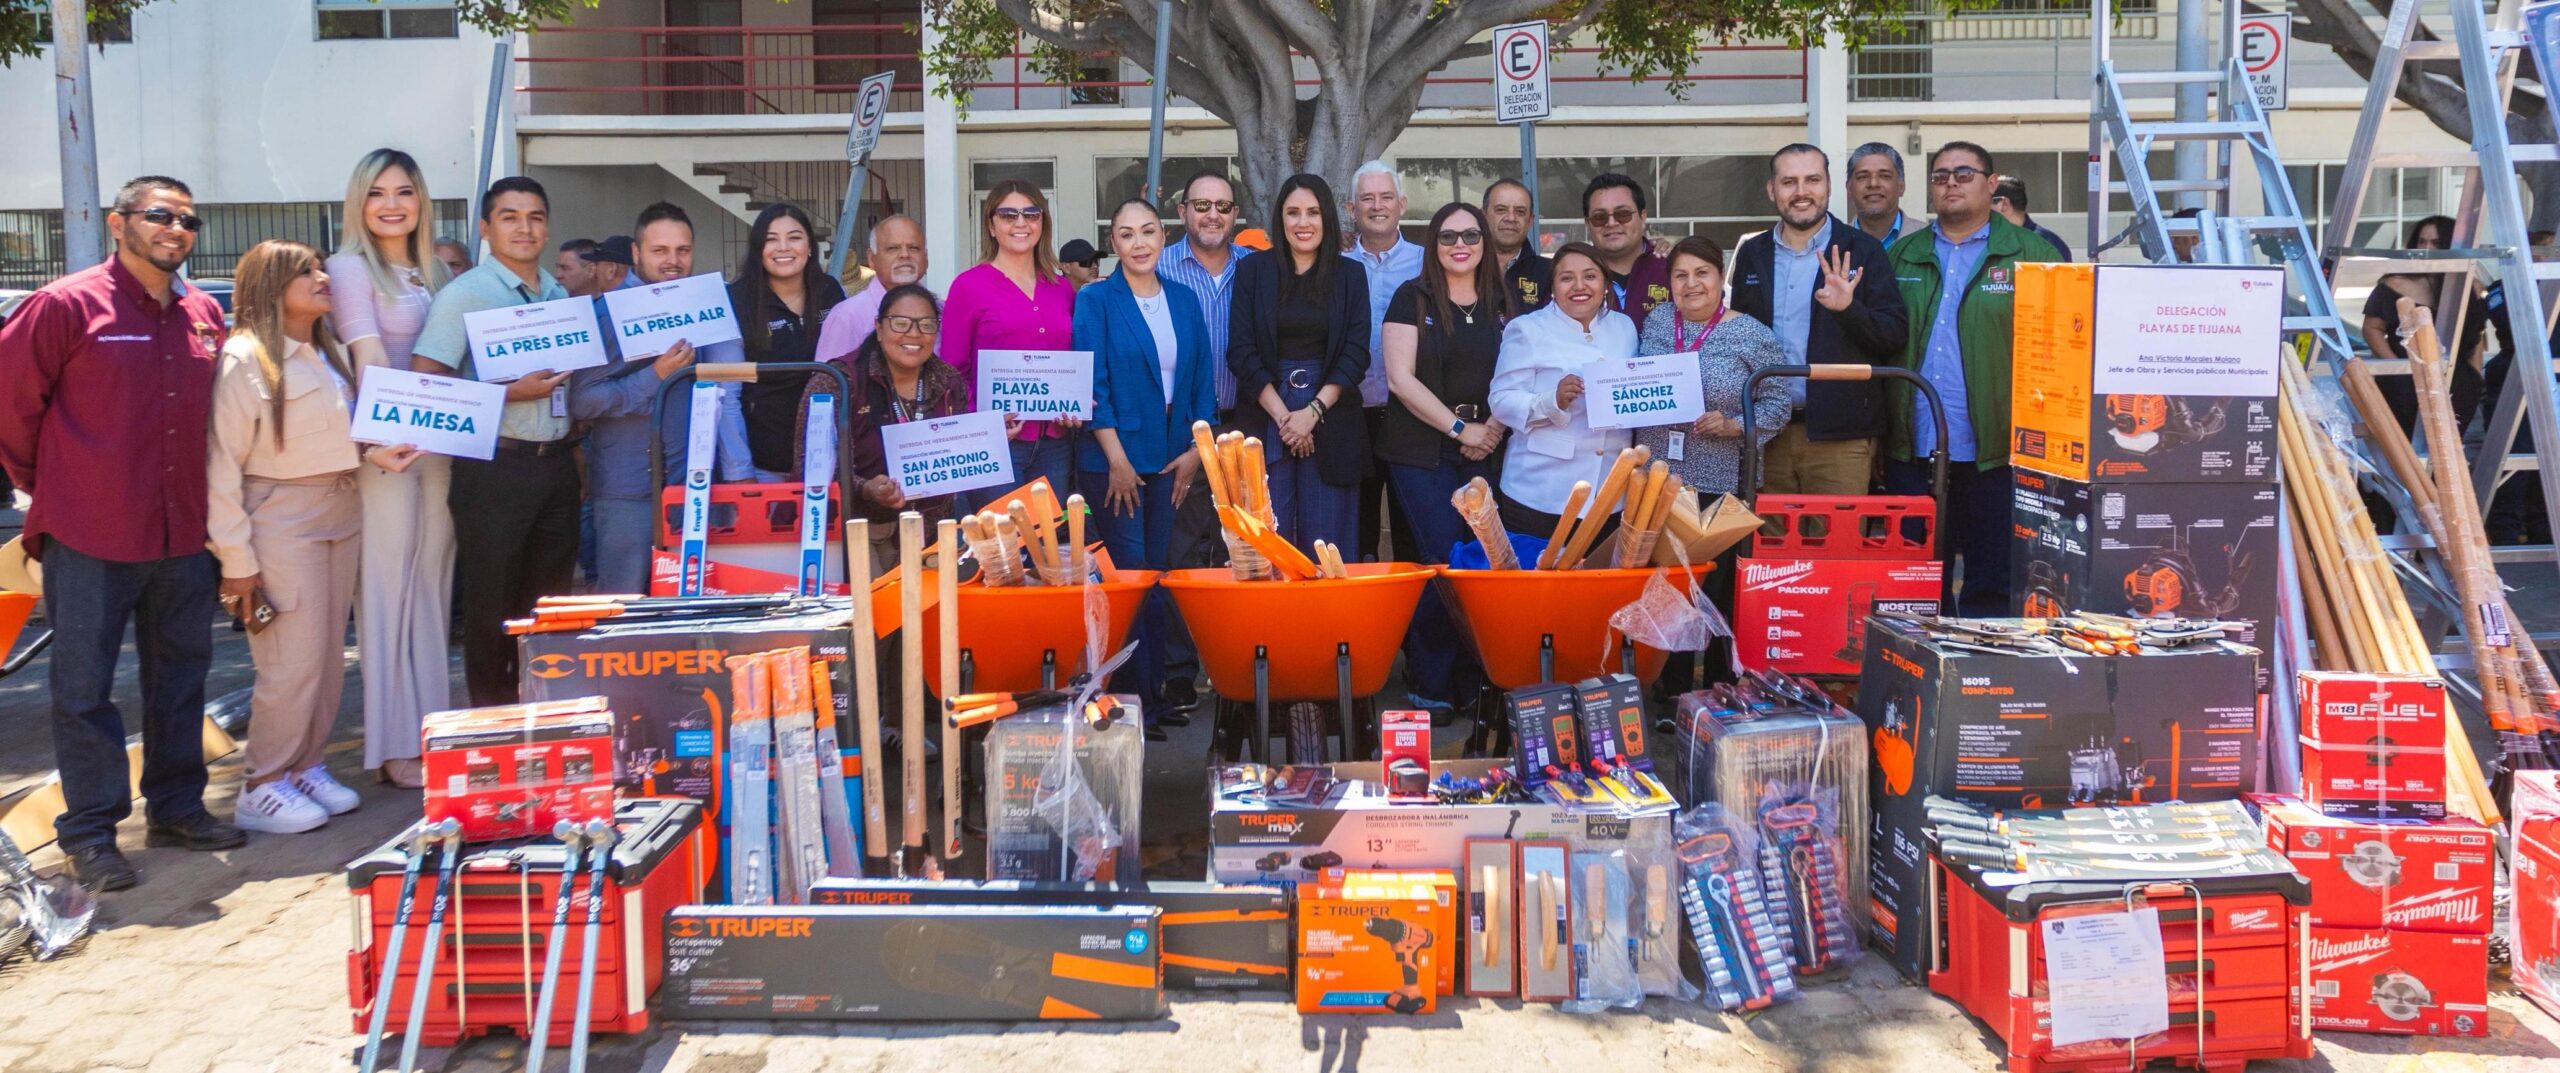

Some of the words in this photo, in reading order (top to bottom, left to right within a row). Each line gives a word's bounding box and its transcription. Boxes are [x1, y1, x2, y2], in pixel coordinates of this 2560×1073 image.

[2242, 32, 2265, 62] E
[1511, 40, 1531, 72] E
[1510, 83, 1534, 93] O.P.M
[1504, 92, 1541, 104] DELEGACION
[863, 89, 880, 120] E
[1508, 104, 1539, 114] CENTRO
[1980, 283, 2014, 292] TIJUANA
[2156, 304, 2226, 316] DELEGACIÓN
[623, 323, 644, 337] LA
[647, 313, 695, 333] PRESA
[699, 306, 726, 322] ALR
[2139, 324, 2180, 334] PLAYAS
[2182, 324, 2195, 334] DE
[2198, 324, 2242, 334] TIJUANA
[486, 344, 508, 358] LA
[512, 337, 551, 354] PRES
[555, 331, 590, 347] ESTE
[2137, 366, 2156, 374] Obra
[2228, 368, 2268, 376] Municipales
[992, 382, 1049, 395] PLAYAS
[1612, 385, 1673, 401] SÁNCHEZ
[992, 400, 1011, 412] DE
[1017, 400, 1081, 412] TIJUANA
[1613, 399, 1677, 414] TABOADA
[371, 403, 401, 424] LA
[410, 408, 475, 434] MESA
[902, 460, 929, 474] SAN
[933, 450, 989, 469] ANTONIO
[905, 475, 921, 487] DE
[924, 470, 948, 483] LOS
[952, 462, 1000, 478] BUENOS
[2016, 474, 2045, 490] TRUPER
[693, 497, 702, 532] Empire
[811, 506, 820, 541] Empire
[1743, 560, 1814, 585] Milwaukee
[1777, 586, 1831, 594] PACKOUT
[1879, 603, 1912, 611] MOST
[819, 646, 848, 654] 16095
[578, 650, 723, 677] TRUPER
[1892, 652, 1925, 679] TRUPER
[1962, 678, 1990, 686] 16095
[1584, 692, 1608, 701] TRUPER
[1962, 687, 2014, 696] COMP-KIT50
[1518, 698, 1542, 708] TRUPER
[2328, 706, 2355, 714] M18
[2360, 704, 2437, 716] FUEL
[1026, 735, 1087, 746] TRUER
[1004, 774, 1016, 790] 5
[1010, 808, 1029, 817] 800
[2167, 804, 2227, 813] TRUER
[1239, 814, 1296, 826] TRUPER
[1422, 812, 1469, 820] INALÁMBRICA
[1268, 822, 1304, 836] max
[1894, 832, 1906, 850] 116
[1906, 842, 1920, 861] PSI
[843, 892, 911, 904] TRUPER
[1330, 906, 1390, 916] TRUPER
[2229, 908, 2268, 926] Milwaukee
[2384, 896, 2484, 926] Milwaukee
[706, 918, 812, 937] TRUPER
[669, 938, 724, 948] Cortapernos
[669, 948, 686, 956] Bolt
[688, 948, 714, 956] cutter
[670, 958, 697, 972] 36"
[2317, 1017, 2369, 1026] TOOL-ONLY
